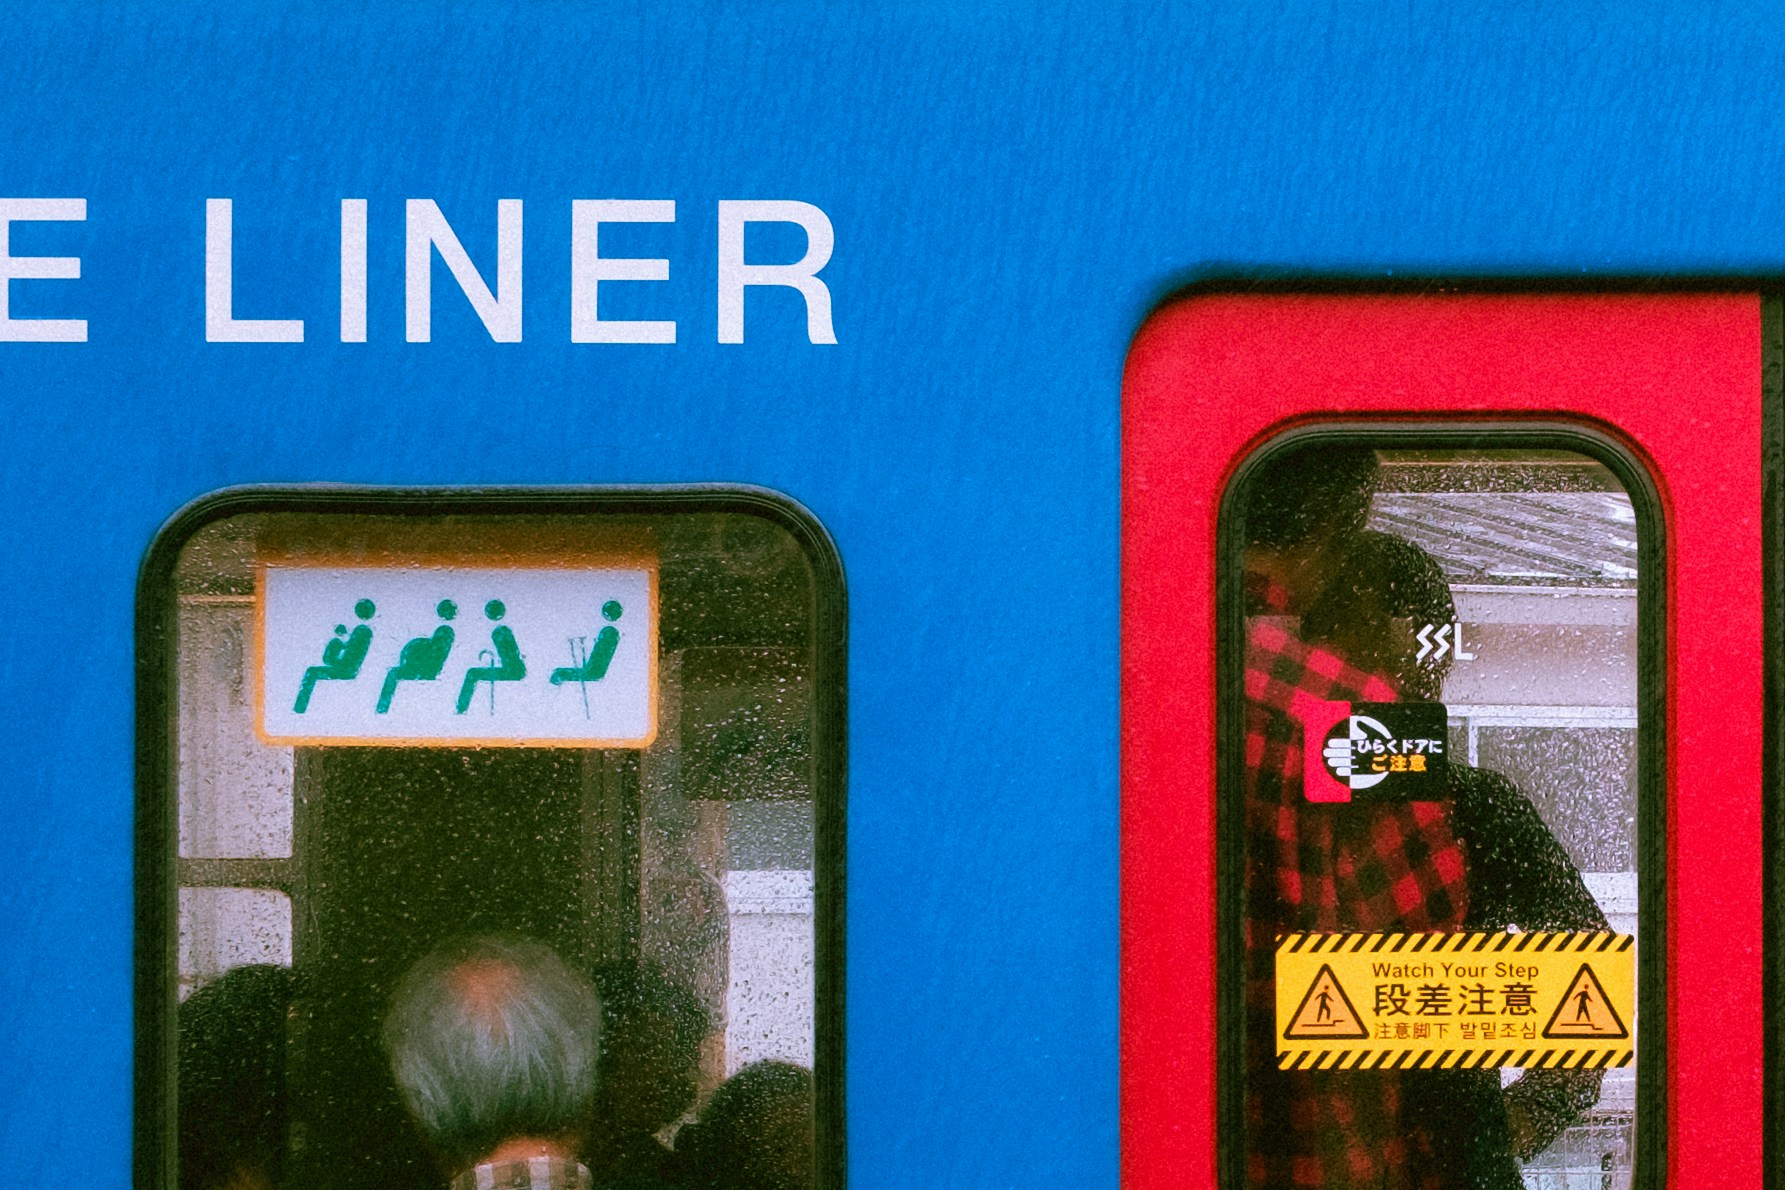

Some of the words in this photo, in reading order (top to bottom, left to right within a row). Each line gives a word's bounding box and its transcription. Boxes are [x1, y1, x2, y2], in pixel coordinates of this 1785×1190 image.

[205, 197, 839, 345] LINER
[1416, 623, 1474, 661] SSL
[1356, 738, 1443, 754] ひらくドアに
[1371, 754, 1427, 772] ご注意
[1372, 962, 1434, 978] Watch
[1440, 962, 1488, 978] Your
[1495, 962, 1540, 980] Step
[1372, 982, 1538, 1017] 段差注意
[1373, 1022, 1450, 1040] 注意脚下
[1460, 1022, 1537, 1040] 발밑조심
